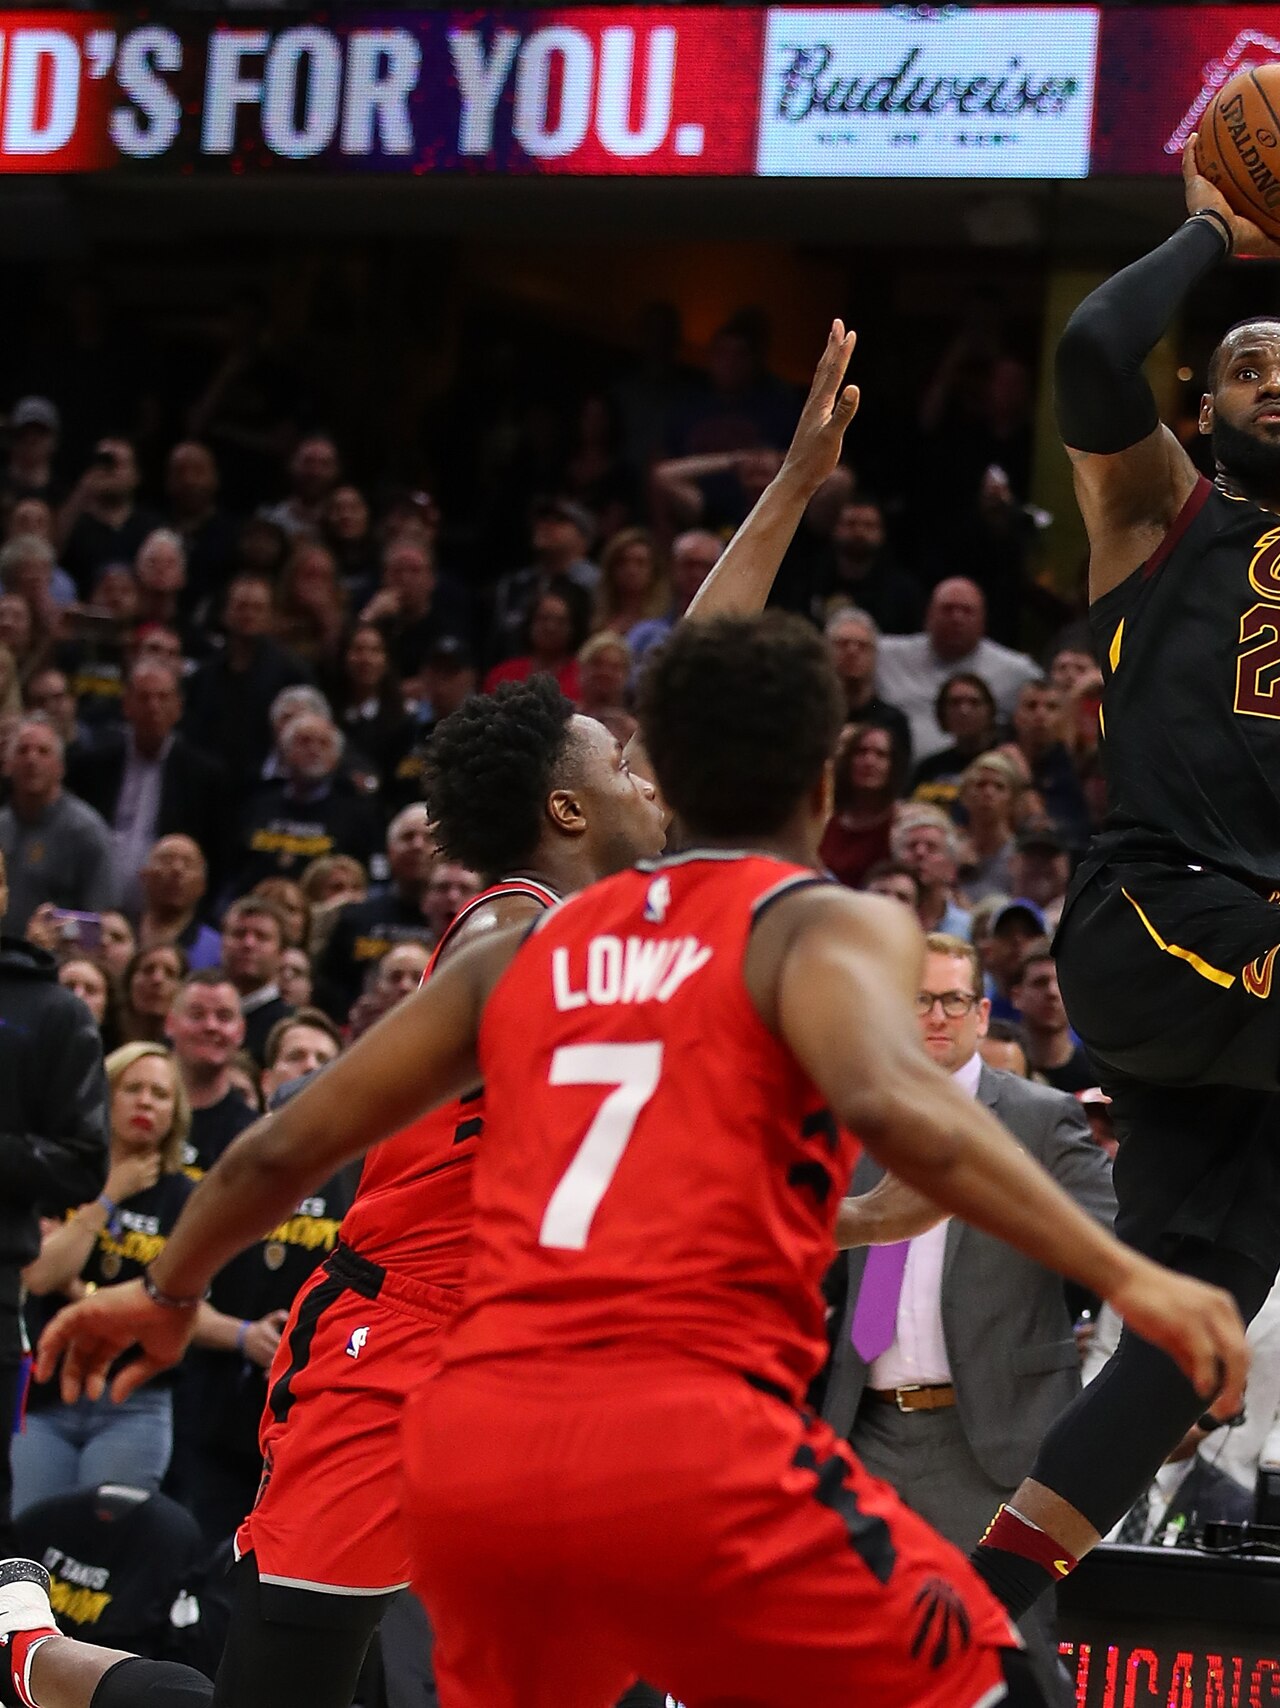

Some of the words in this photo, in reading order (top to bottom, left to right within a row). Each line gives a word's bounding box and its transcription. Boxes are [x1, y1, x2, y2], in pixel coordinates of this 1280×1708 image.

[0, 25, 184, 159] D'S
[200, 25, 422, 158] FOR
[448, 25, 706, 158] YOU.
[779, 42, 1078, 121] Budweiser
[538, 1039, 665, 1251] 7
